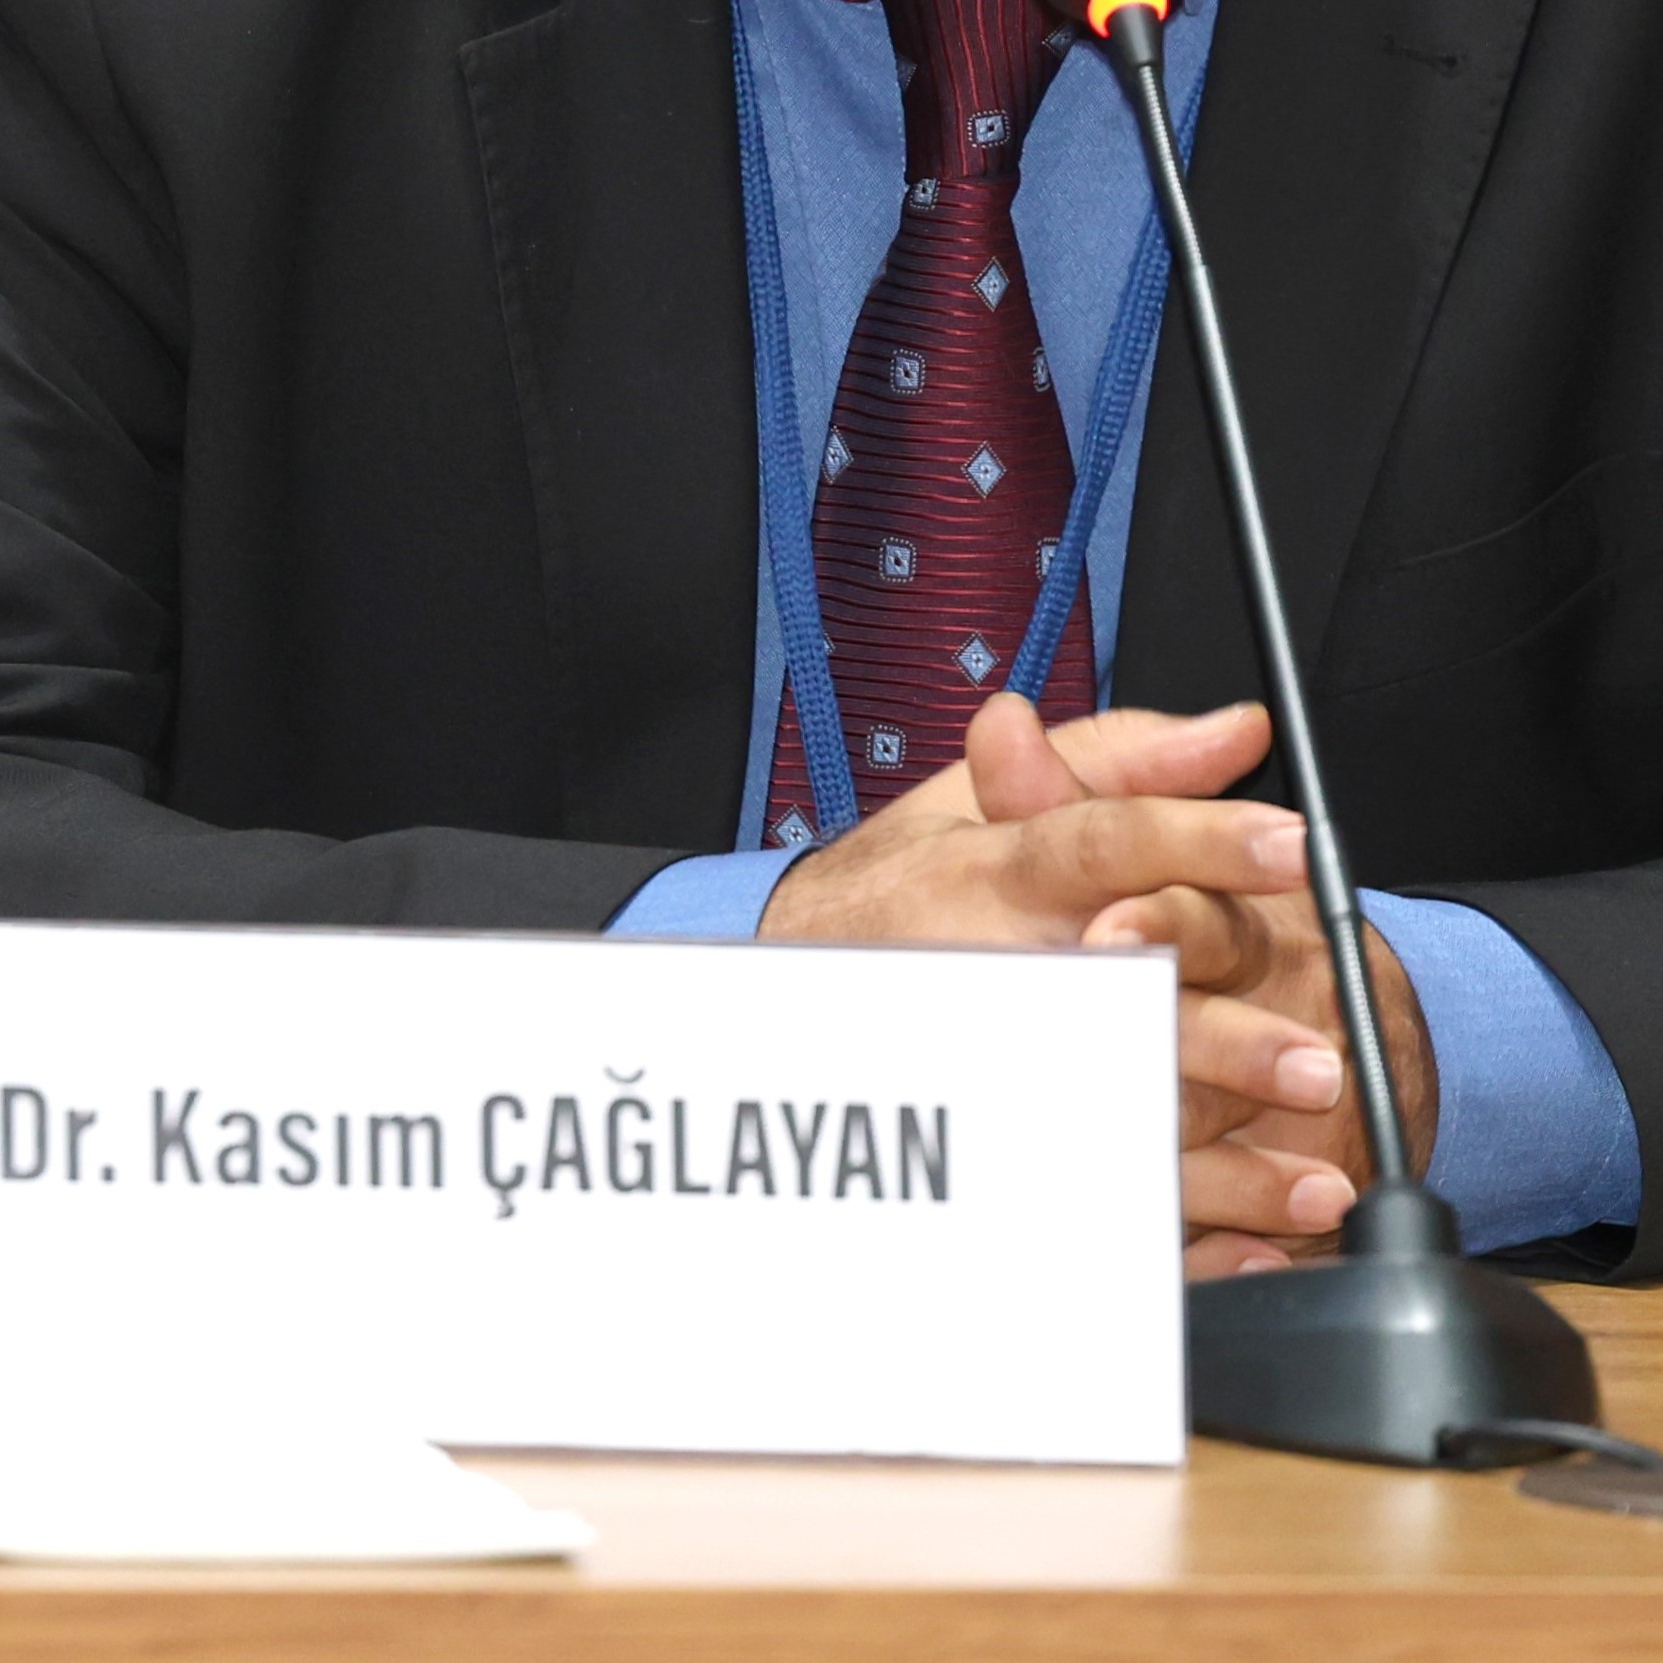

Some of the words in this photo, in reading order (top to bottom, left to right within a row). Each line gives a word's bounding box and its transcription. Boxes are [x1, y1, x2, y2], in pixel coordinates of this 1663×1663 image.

[0, 1085, 117, 1183] Dr.
[151, 1088, 444, 1189] Kasım
[479, 1067, 950, 1219] ÇAĞLAYAN
